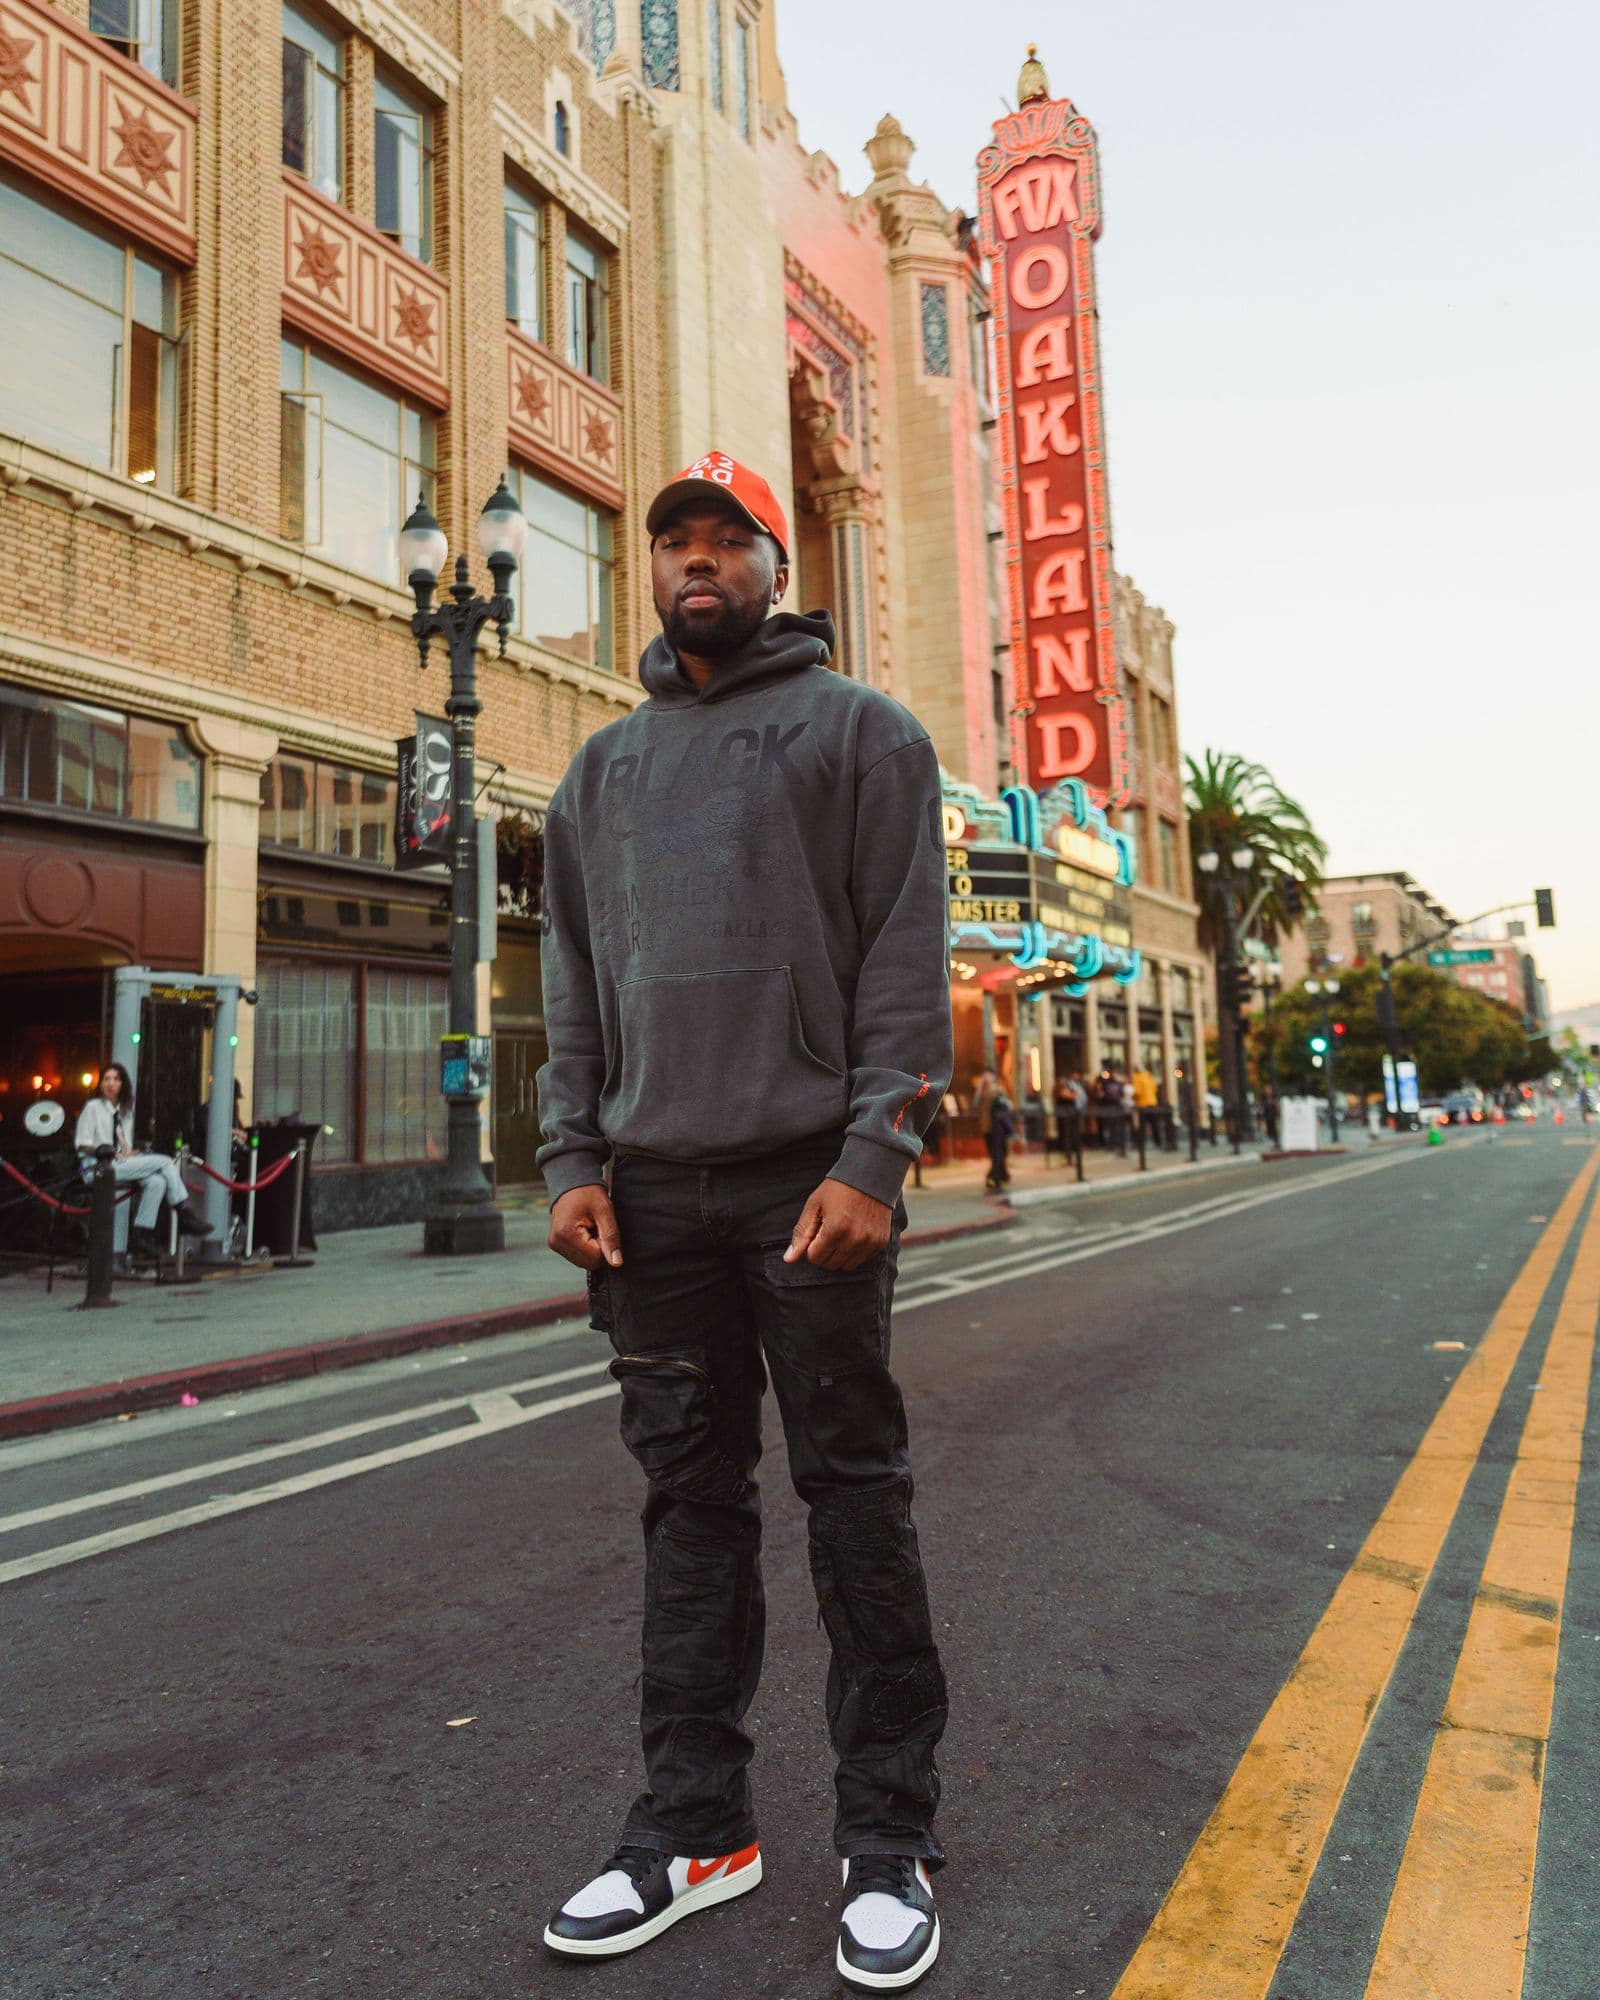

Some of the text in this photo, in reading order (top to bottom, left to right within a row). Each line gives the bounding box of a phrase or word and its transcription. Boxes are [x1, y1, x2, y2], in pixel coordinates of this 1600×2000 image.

[992, 163, 1080, 240] FOX
[1010, 243, 1097, 779] OAKLAND
[604, 720, 811, 807] BLACK
